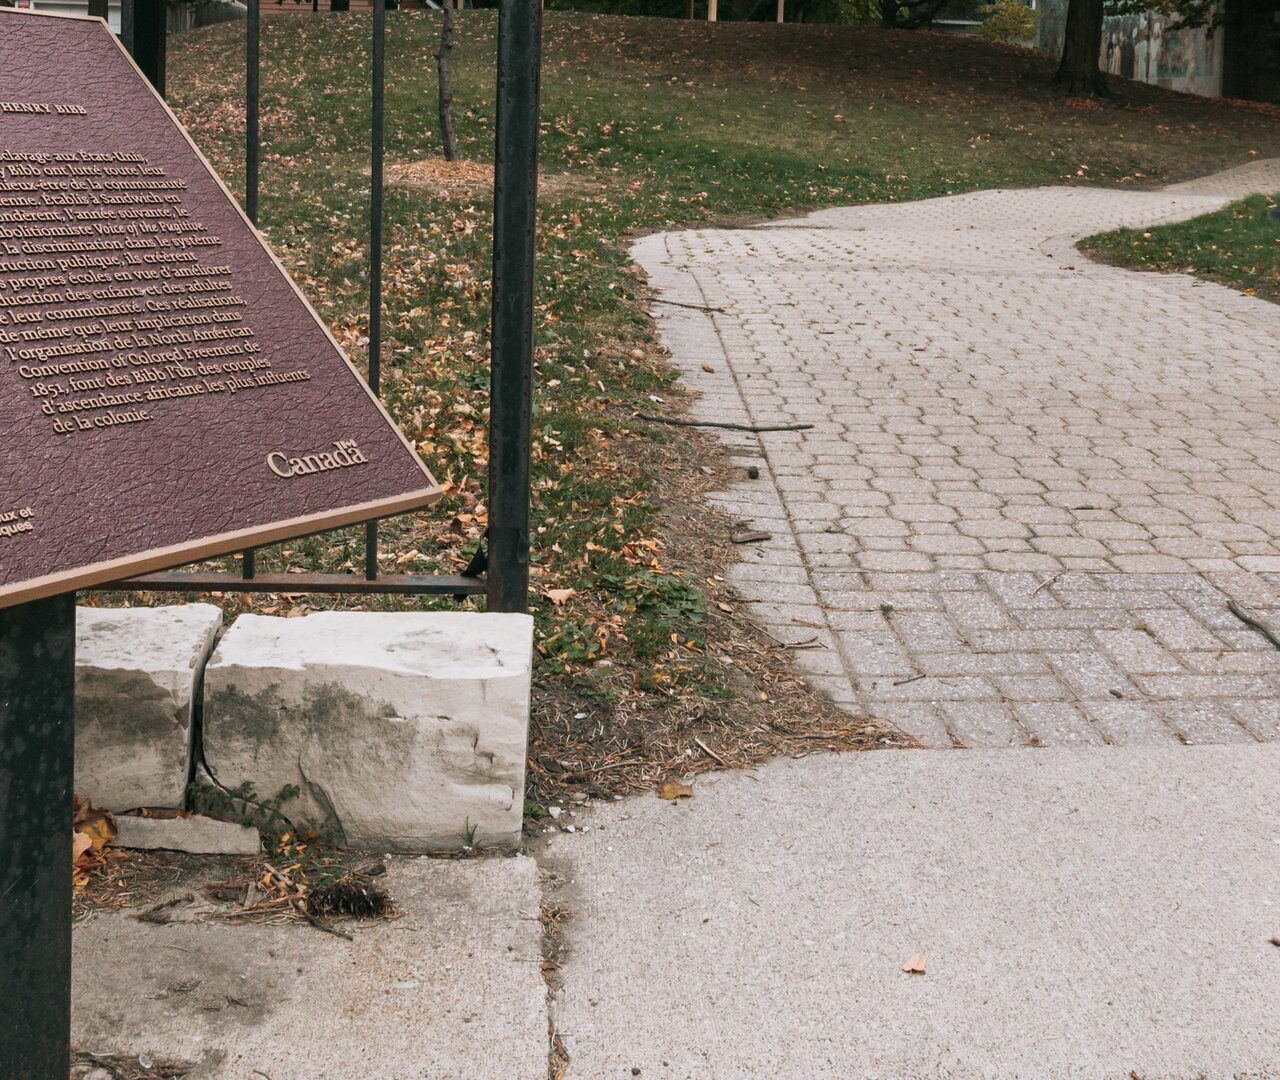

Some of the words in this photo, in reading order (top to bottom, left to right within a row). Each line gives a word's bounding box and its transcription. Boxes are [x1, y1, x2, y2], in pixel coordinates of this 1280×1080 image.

[0, 101, 50, 112] HENRY
[54, 103, 87, 114] BIBB
[52, 152, 79, 161] aux
[41, 192, 89, 205] Établis
[88, 192, 100, 204] à
[99, 191, 163, 204] Sandwich
[163, 193, 181, 202] en
[117, 206, 176, 218] suivante,
[172, 204, 189, 216] le
[92, 222, 125, 234] Voice
[126, 221, 139, 236] of
[138, 219, 158, 232] the
[158, 219, 208, 234] Fugitive.
[57, 253, 125, 270] publique,
[122, 250, 142, 264] ils
[143, 250, 197, 263] créèrent
[7, 309, 43, 323] leur
[145, 299, 171, 311] Ces
[18, 358, 108, 377] Convention
[110, 352, 127, 367] of
[127, 346, 183, 364] Colored
[182, 344, 243, 358] Freemen
[243, 339, 261, 352] de
[52, 417, 75, 432] de
[72, 414, 93, 429] la
[94, 407, 154, 426] colonie.
[266, 439, 369, 478] Canada
[18, 505, 34, 518] et
